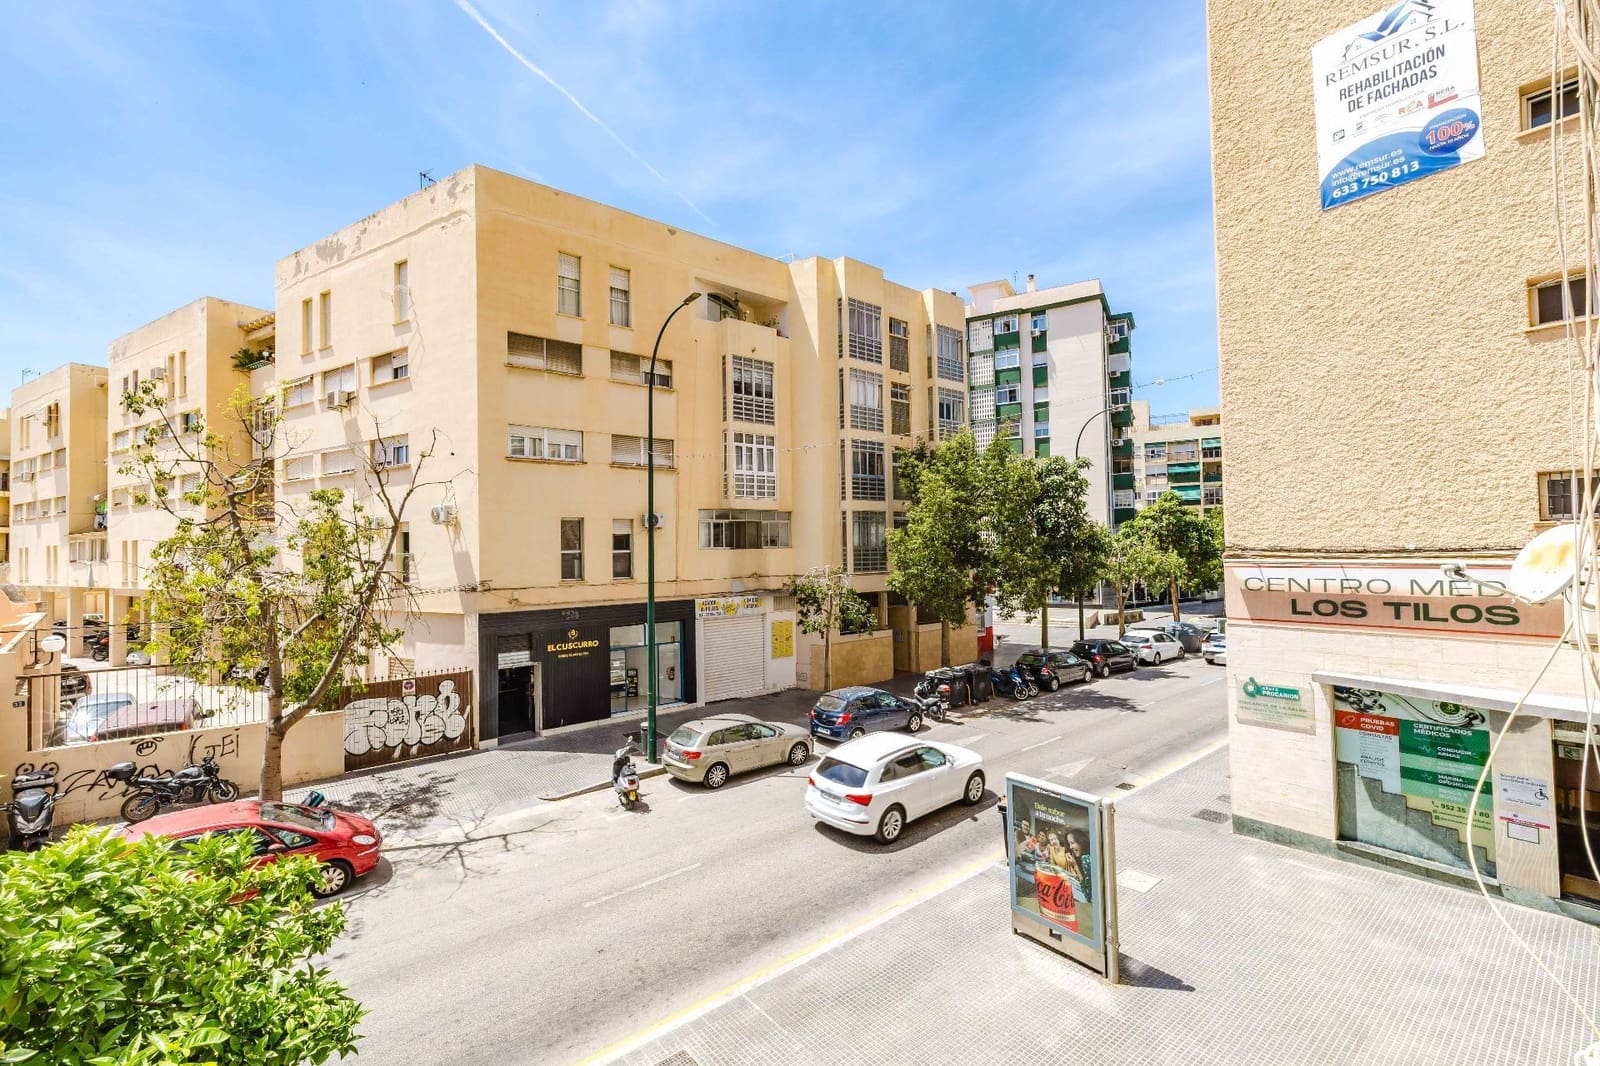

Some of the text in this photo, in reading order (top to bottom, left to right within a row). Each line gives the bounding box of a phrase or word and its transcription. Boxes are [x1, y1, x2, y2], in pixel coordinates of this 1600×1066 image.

[1424, 18, 1465, 42] S.L.
[1338, 44, 1446, 102] REHABILITACIÓN
[1347, 96, 1364, 113] DE
[1366, 65, 1438, 105] FACHADAS
[1425, 120, 1476, 145] 100%
[1331, 148, 1404, 179] www.remsur.es
[1331, 156, 1405, 187] info@remsur.es
[1332, 160, 1420, 198] 633 750 813
[1244, 576, 1507, 598] CENTRO MED
[1290, 598, 1521, 626] LOS TILOS
[1360, 717, 1395, 727] PRUEBAS
[1360, 723, 1385, 732] COVID
[1413, 723, 1473, 736] CERTIFICADOS
